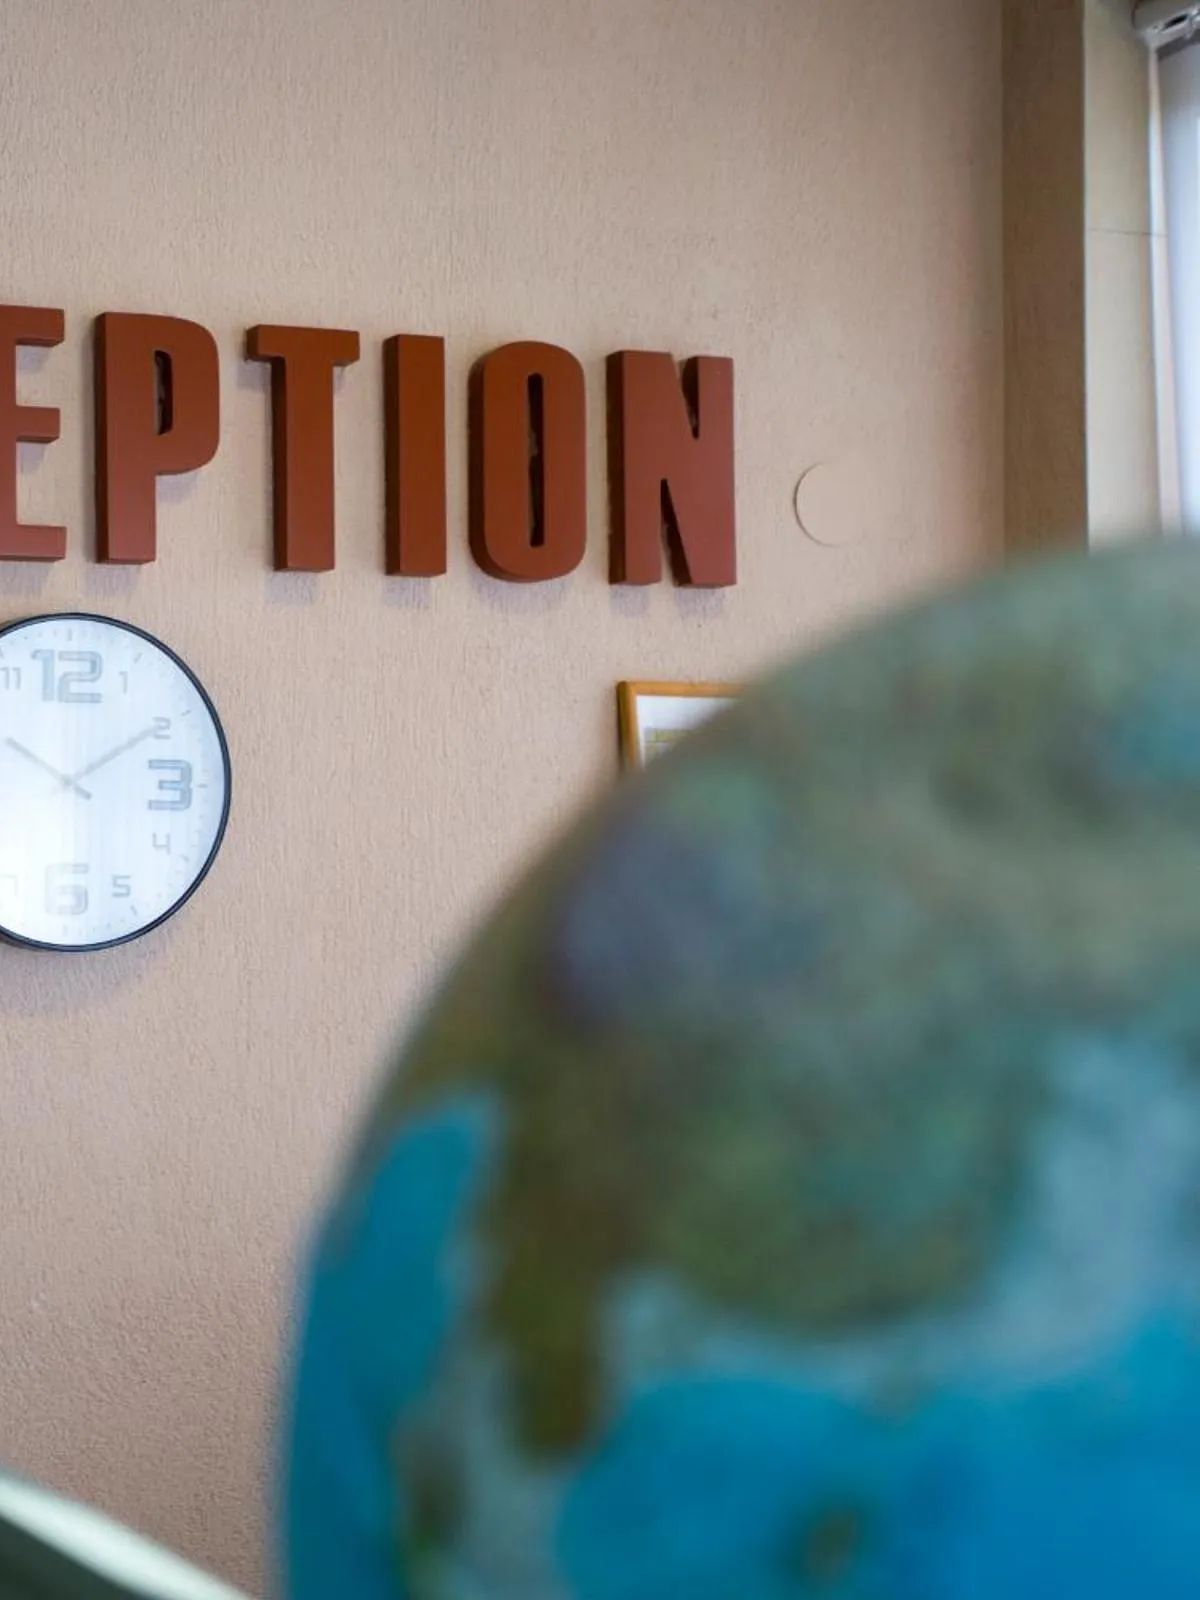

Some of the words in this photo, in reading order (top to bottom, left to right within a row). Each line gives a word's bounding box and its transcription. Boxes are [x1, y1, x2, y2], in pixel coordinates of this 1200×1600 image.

[0, 667, 22, 690] 11
[31, 648, 103, 703] 12
[118, 671, 129, 694] 1
[152, 717, 172, 740] 2
[147, 758, 193, 811] 3
[152, 832, 171, 855] 4
[44, 863, 90, 916] 6
[111, 874, 132, 898] 5
